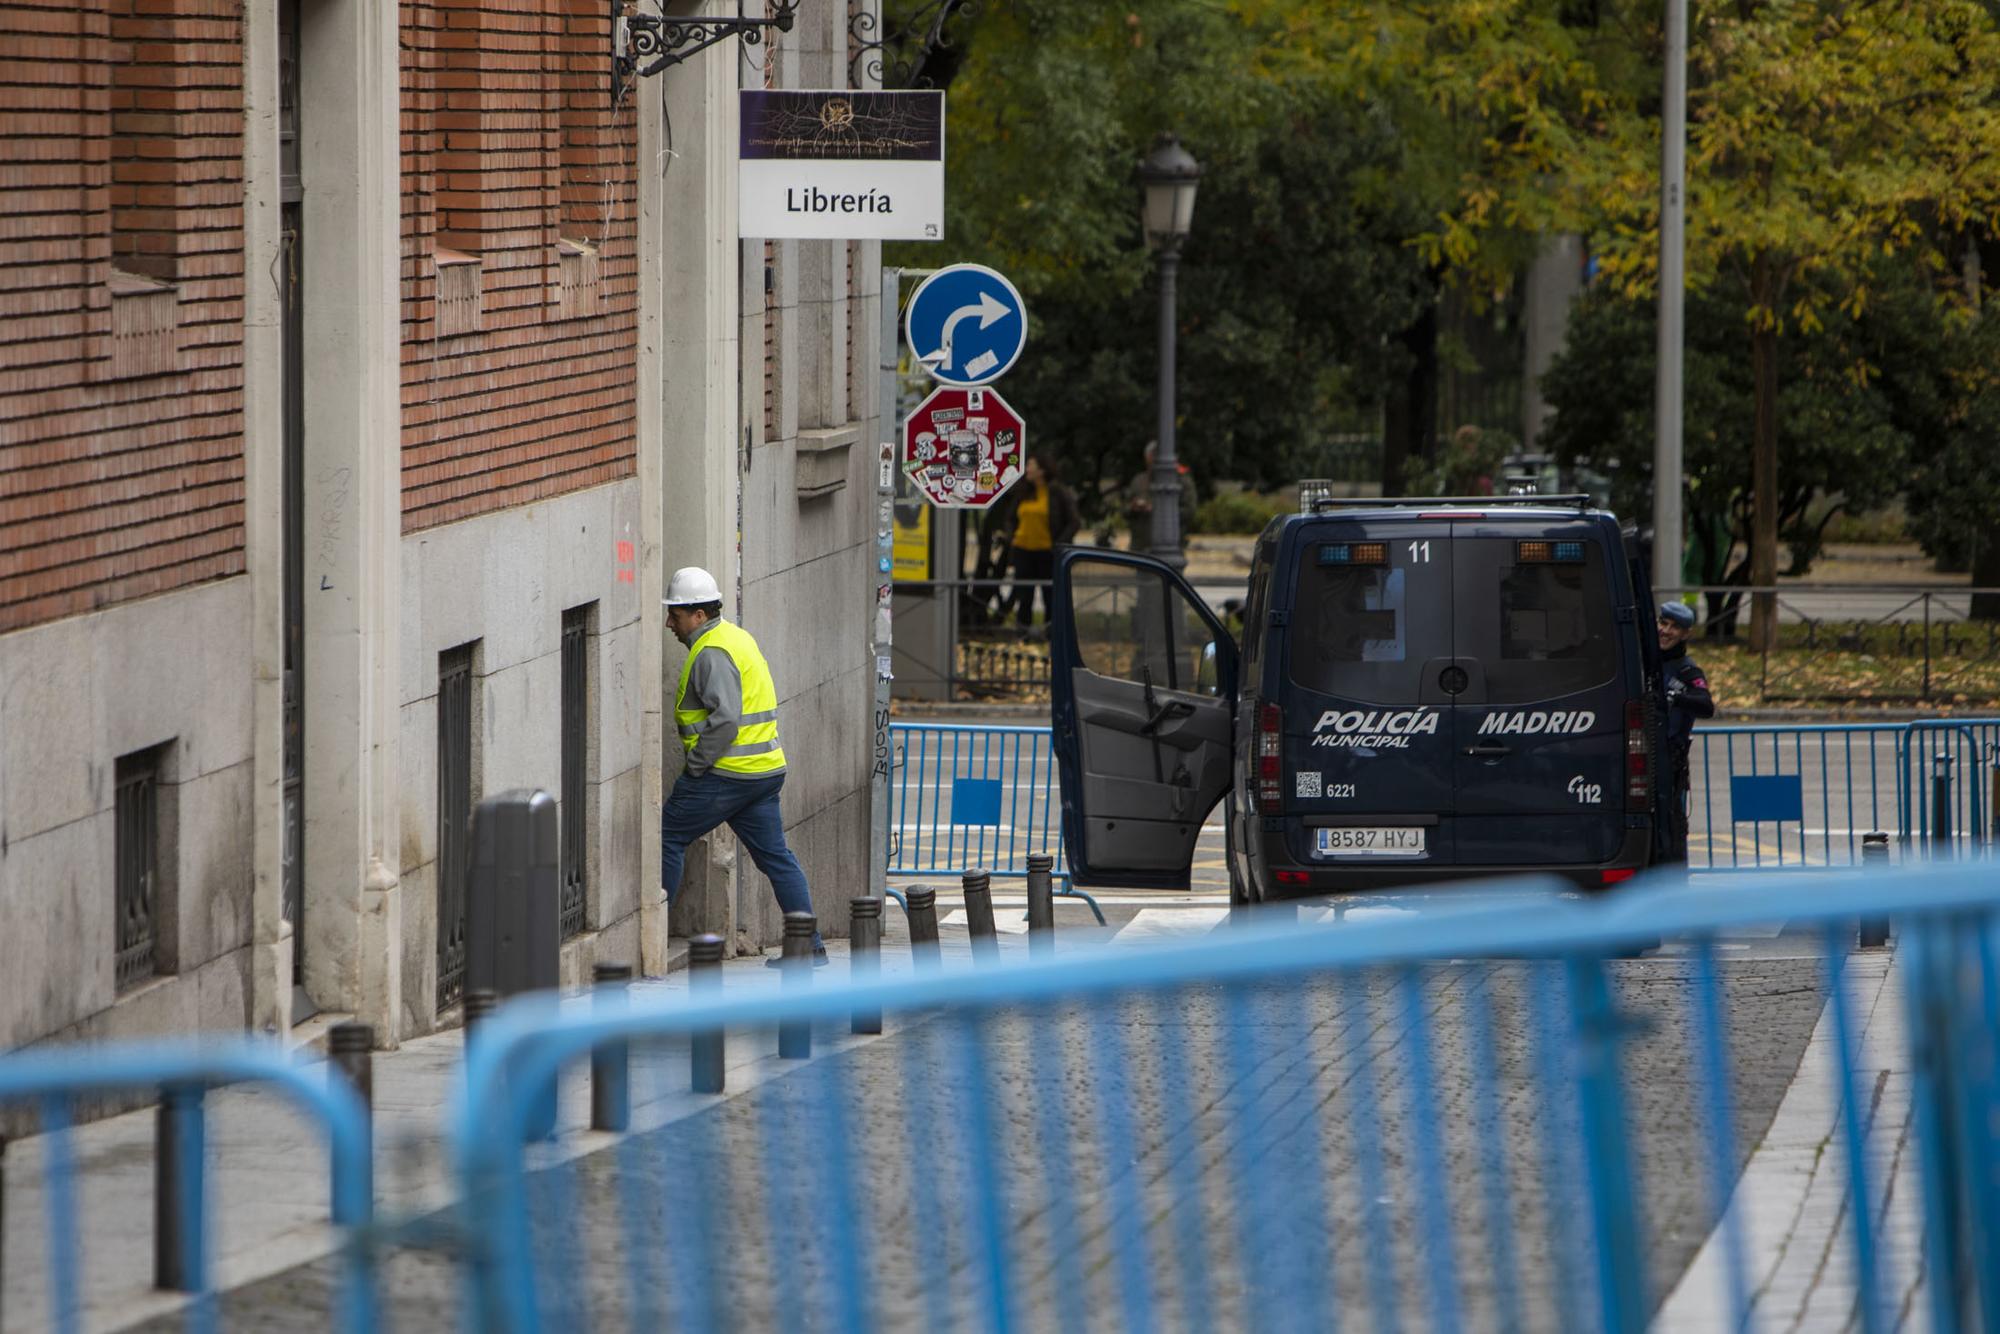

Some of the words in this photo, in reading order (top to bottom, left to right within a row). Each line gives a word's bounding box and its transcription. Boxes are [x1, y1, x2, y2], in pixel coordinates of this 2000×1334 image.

[787, 186, 893, 213] Librería
[914, 431, 1016, 462] SP
[1408, 540, 1431, 563] 11
[1312, 705, 1440, 735] POLICÍA
[1477, 711, 1596, 735] MADRID
[1311, 734, 1410, 748] MUNICIPAL
[1326, 784, 1355, 798] 6221
[1576, 783, 1602, 804] 112
[1330, 830, 1377, 848] 8587
[1384, 830, 1419, 848] HYJ
